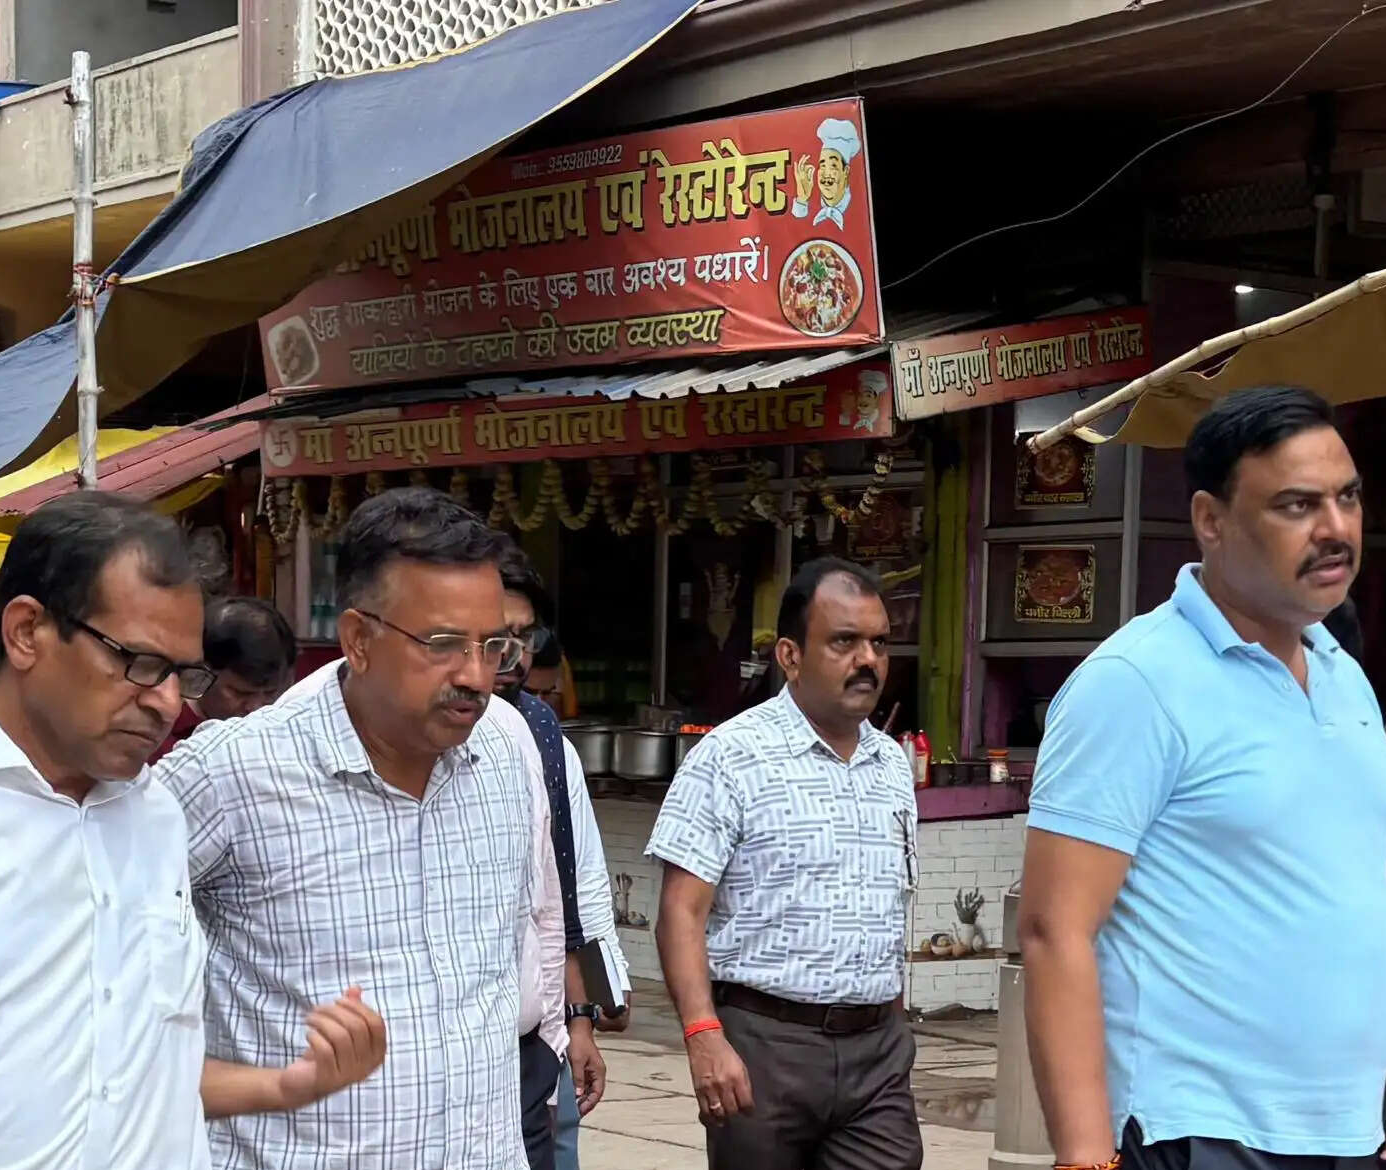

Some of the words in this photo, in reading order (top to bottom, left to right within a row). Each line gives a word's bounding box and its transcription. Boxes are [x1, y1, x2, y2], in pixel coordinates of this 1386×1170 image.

[447, 182, 587, 254] भोजनालय
[594, 151, 650, 233] एवं
[423, 278, 474, 315] भोजन
[477, 271, 497, 307] के
[503, 267, 540, 310] लिए
[544, 271, 578, 310] एक
[583, 267, 615, 296] बार
[622, 258, 687, 293] अवश्य
[422, 327, 449, 369] के
[524, 312, 559, 359] की
[564, 319, 620, 354] उत्तम
[624, 308, 726, 348] व्यवस्था
[927, 335, 993, 396] अन्नपूर्णा
[996, 334, 1068, 381] भोजनालय
[345, 405, 461, 465] अन्नपूर्णा
[474, 402, 628, 452] भोजनालय
